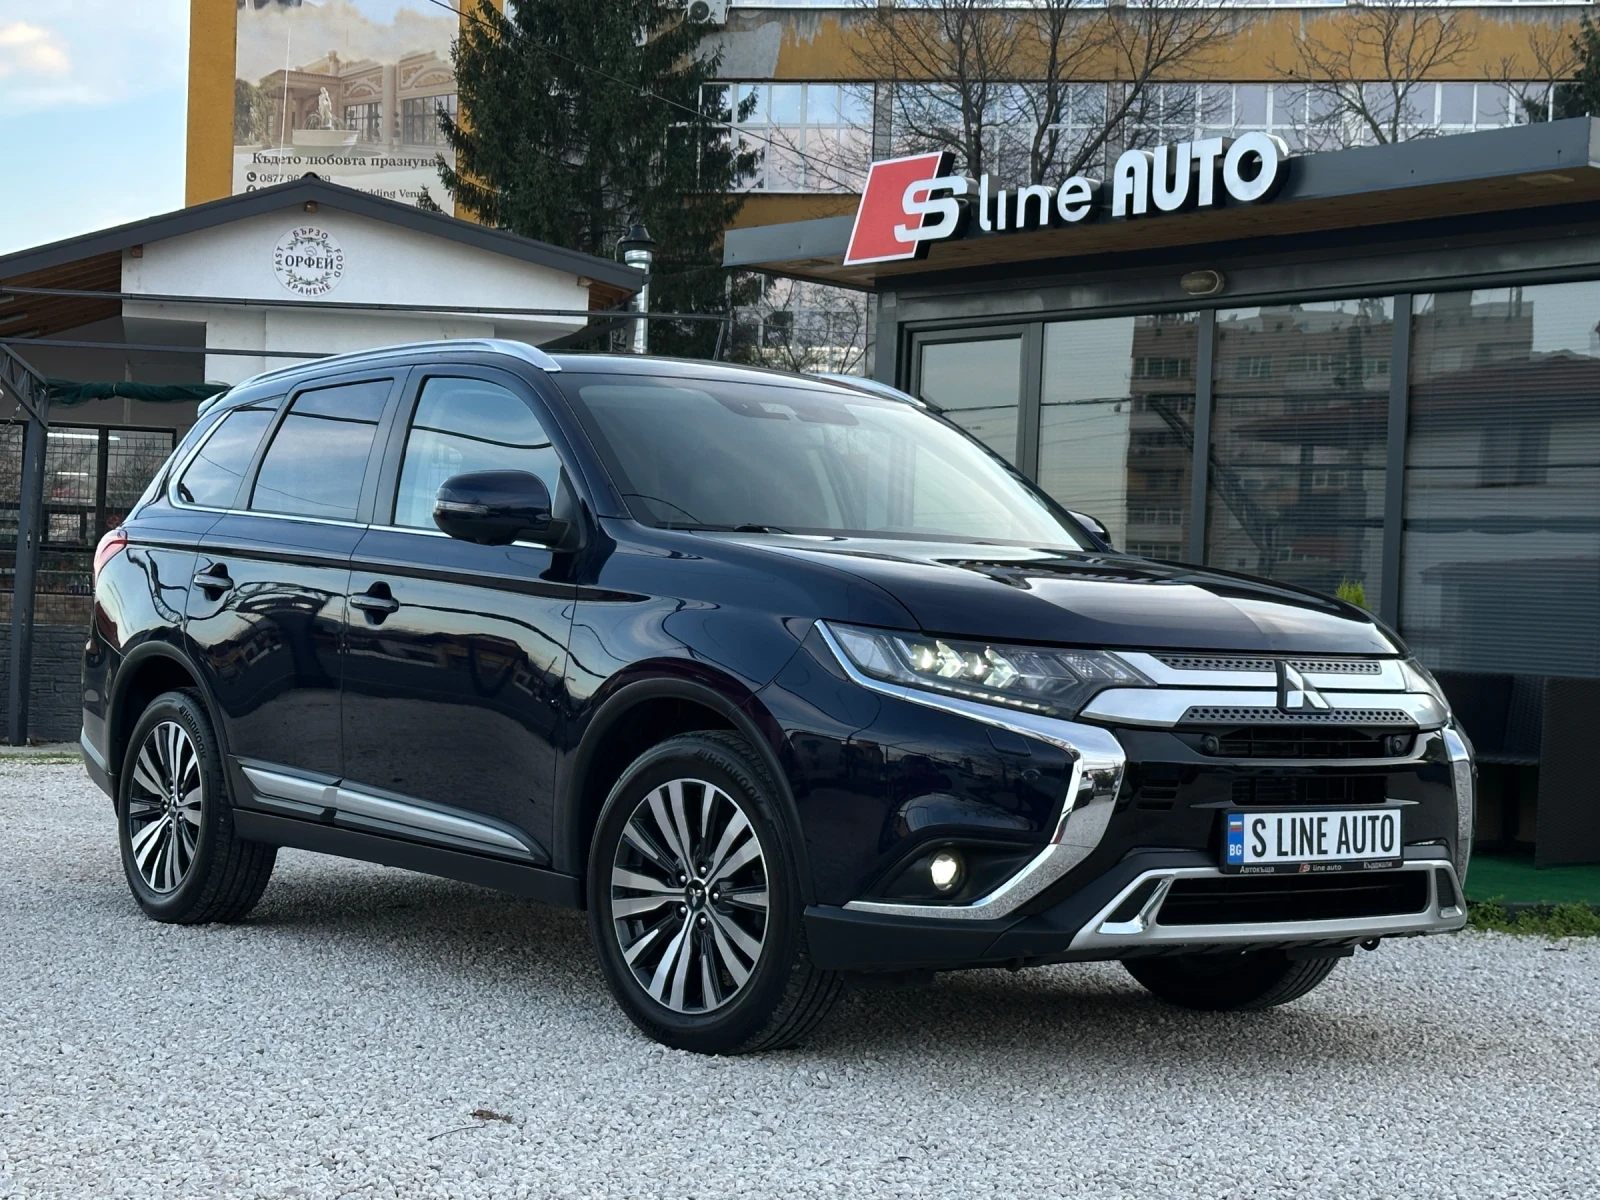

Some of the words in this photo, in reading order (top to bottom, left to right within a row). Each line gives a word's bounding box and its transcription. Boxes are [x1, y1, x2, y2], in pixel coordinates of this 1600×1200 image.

[252, 153, 301, 166] Където
[306, 154, 366, 166] любовта
[371, 157, 437, 169] празнува
[260, 174, 284, 183] 0877
[893, 176, 968, 243] S
[979, 173, 1092, 232] line
[1112, 131, 1282, 218] AUTO
[292, 227, 328, 239] БЪРЗО
[275, 246, 284, 272] FAST
[334, 248, 344, 278] FOOD
[286, 279, 331, 295] ХРАНЕНЕ
[1251, 818, 1267, 858] S
[1276, 817, 1328, 856] LINE
[1336, 814, 1394, 854] AUTO
[1229, 844, 1242, 856] BG
[1239, 865, 1275, 874] Автокъща
[1312, 864, 1326, 872] line
